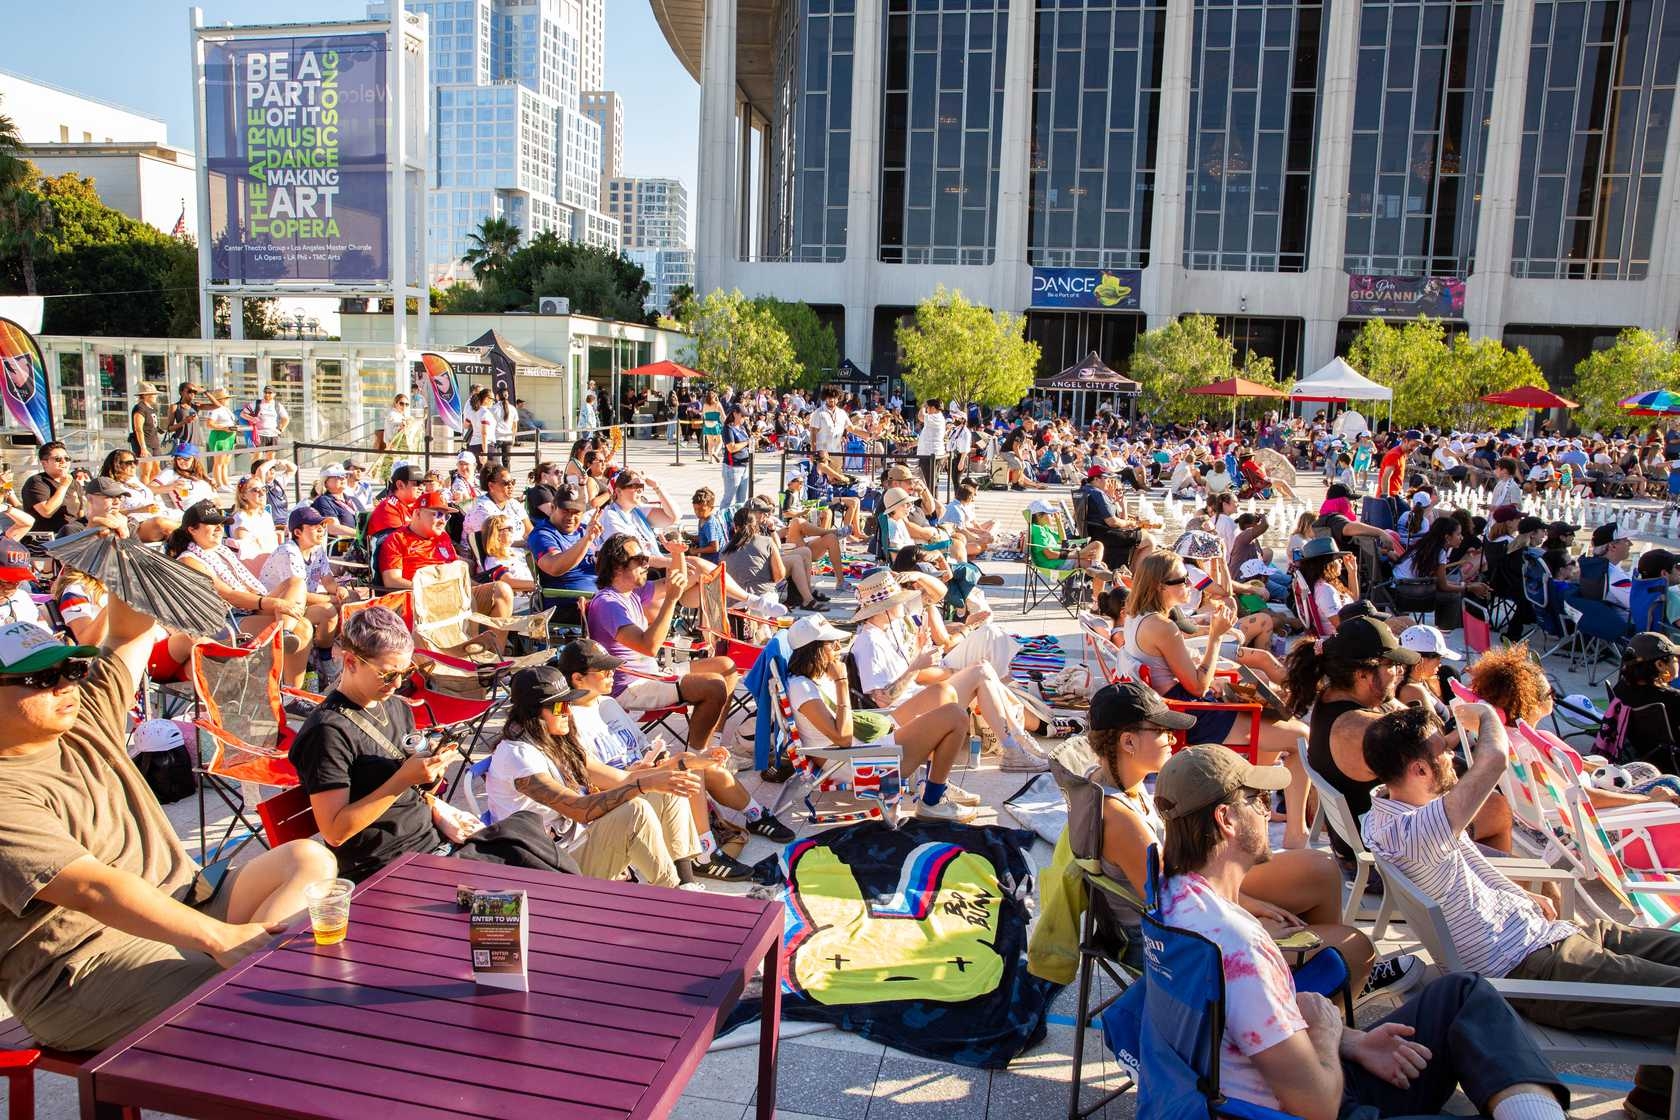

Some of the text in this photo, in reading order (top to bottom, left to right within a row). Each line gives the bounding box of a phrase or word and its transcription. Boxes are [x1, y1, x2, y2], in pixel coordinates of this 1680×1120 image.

[247, 51, 321, 82] BE A
[247, 80, 321, 107] PART
[322, 50, 339, 126] SONG
[266, 106, 320, 127] OF IT
[268, 127, 338, 148] MUSIC
[268, 148, 338, 169] DANCE
[248, 108, 269, 239] THEATRE
[268, 169, 339, 186] MAKING
[269, 186, 339, 219] ART
[270, 219, 340, 239] OPERA
[1034, 276, 1095, 292] DANCE
[1350, 290, 1417, 301] GIOVANNI
[465, 365, 485, 374] CITY
[1051, 381, 1082, 389] ANGEL
